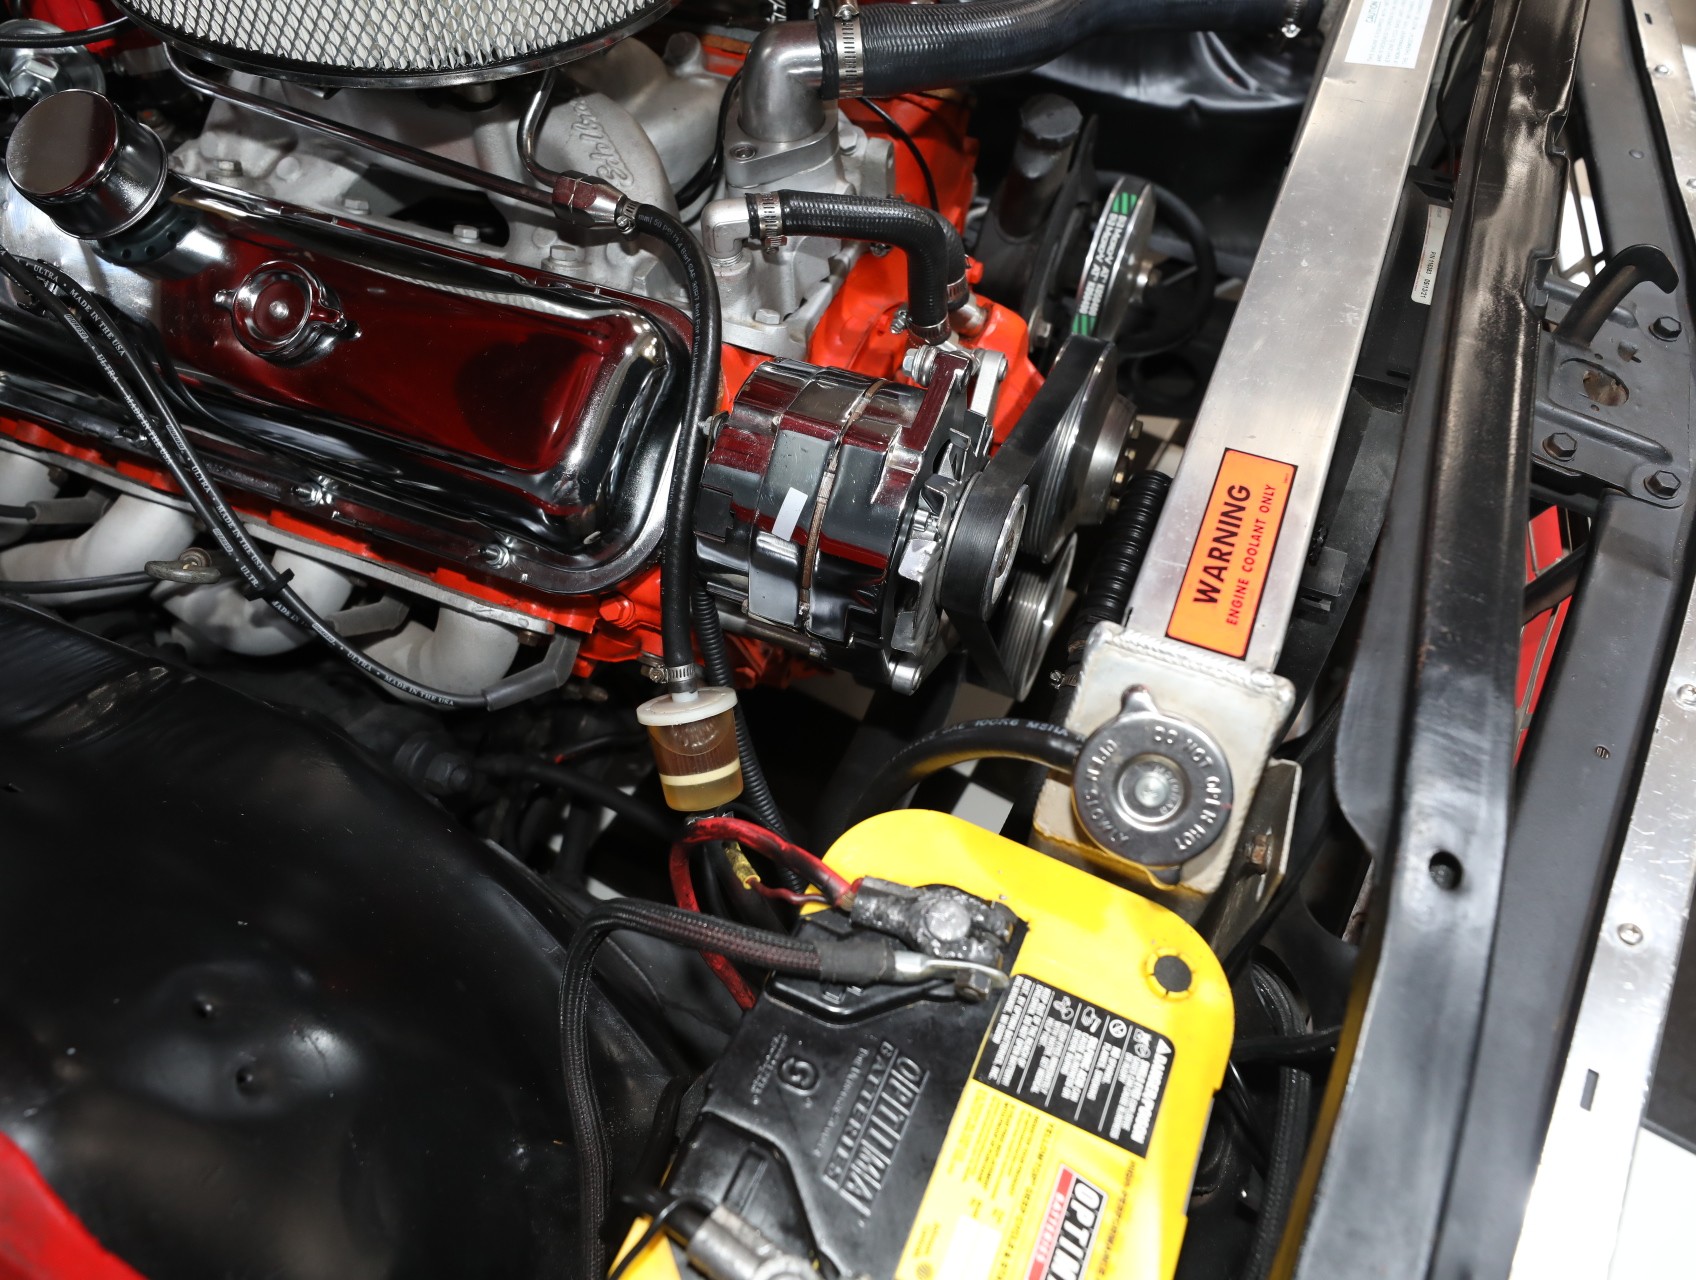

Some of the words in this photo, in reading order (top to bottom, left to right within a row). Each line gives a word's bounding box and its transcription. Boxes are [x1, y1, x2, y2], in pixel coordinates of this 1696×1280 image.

[33, 265, 59, 283] ULTRA
[70, 288, 92, 313] MADE
[90, 312, 101, 322] IN
[98, 321, 113, 340] THE
[112, 339, 126, 357] USA
[96, 353, 118, 383] ULTRA
[124, 394, 142, 420] MADE
[140, 418, 151, 431] IN
[149, 430, 162, 449] THE
[160, 447, 172, 466] USA
[191, 465, 212, 494] ULTRA
[216, 505, 234, 530] MADE
[232, 528, 241, 539] IN
[239, 538, 255, 557] THE
[251, 555, 266, 571] USA
[1193, 484, 1250, 604] WARNING
[1226, 577, 1249, 626] ENGINE
[1242, 518, 1266, 573] COOLANT
[1259, 484, 1276, 514] ONLY
[240, 565, 259, 588] ULTR
[347, 651, 372, 672] ULTRA
[384, 675, 408, 693] MADE
[408, 686, 419, 696] IN
[420, 691, 437, 703] THE
[438, 697, 455, 706] USA
[1187, 737, 1213, 768] NOT
[1174, 823, 1207, 850] HOT
[829, 1041, 894, 1176] BATTERIES
[846, 1057, 922, 1199] OPTIMA
[1046, 1181, 1100, 1280] OPTIM
